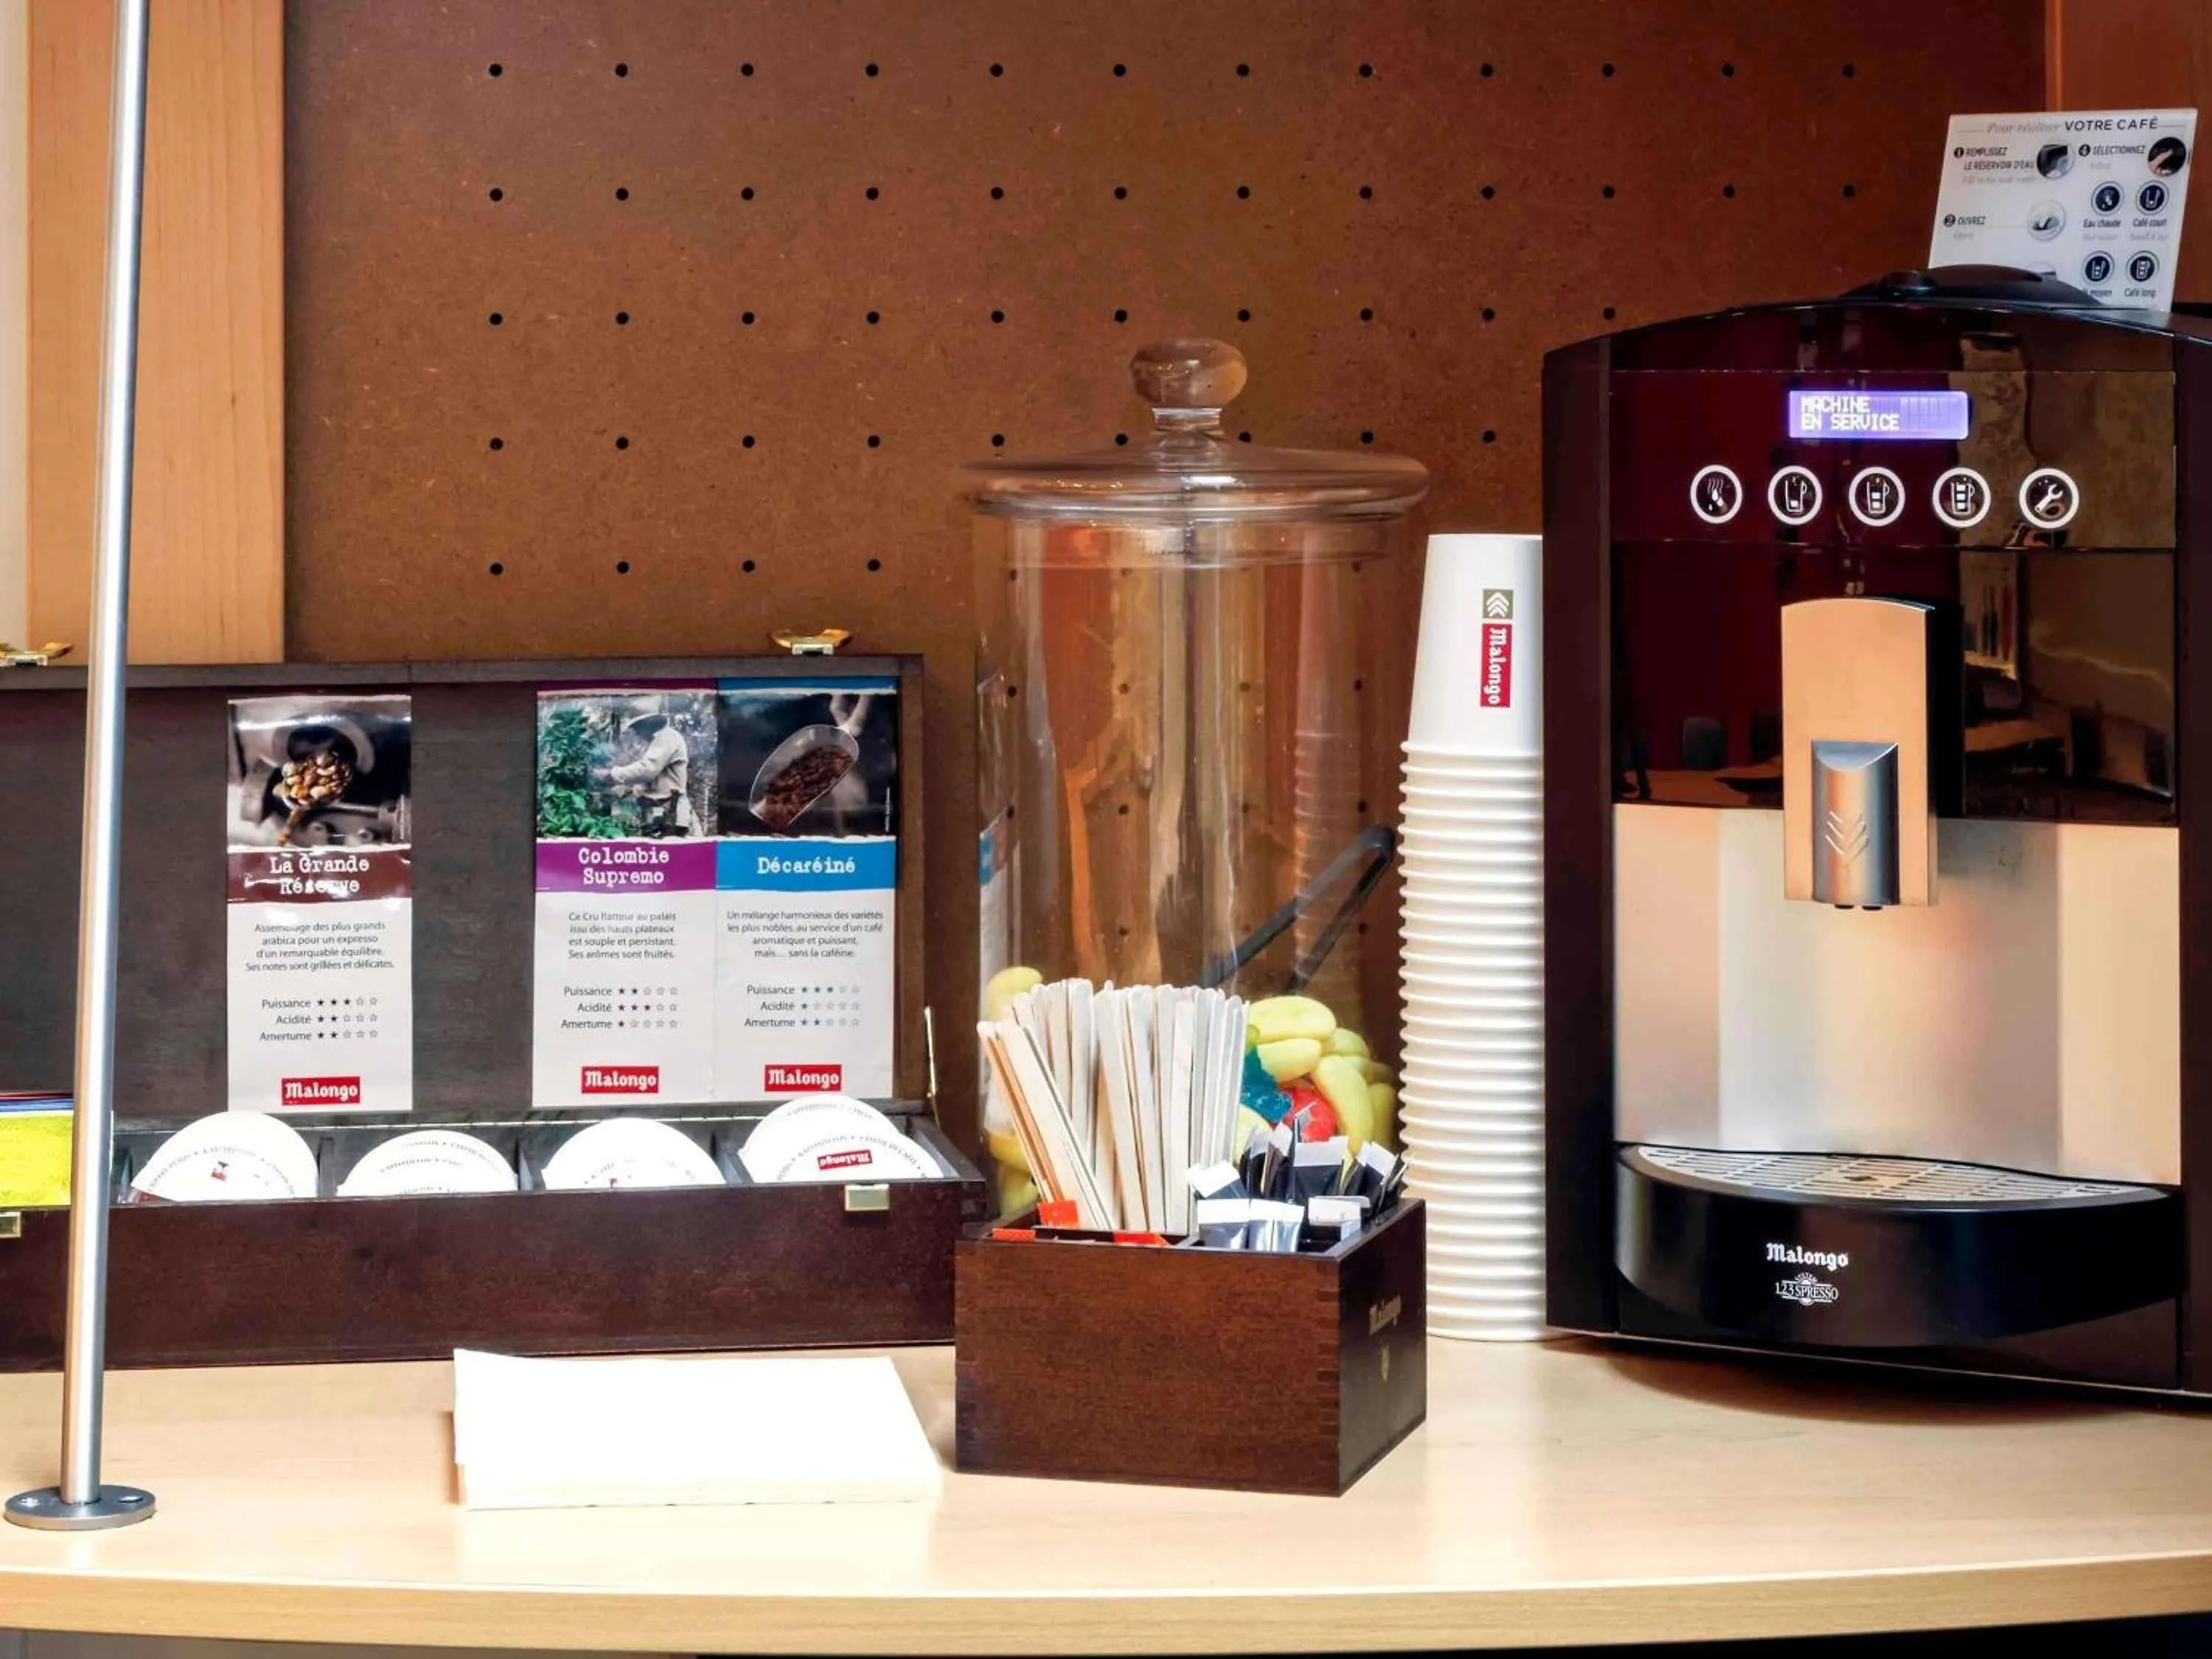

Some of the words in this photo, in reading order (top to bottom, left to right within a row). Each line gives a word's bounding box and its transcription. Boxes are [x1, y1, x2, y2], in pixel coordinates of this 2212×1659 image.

[2065, 119, 2112, 131] VOTRE
[2117, 116, 2158, 131] CAFÉ
[1801, 396, 1870, 413] MACHINE
[1801, 414, 1821, 430] EN
[1831, 414, 1900, 431] SERVICE
[1484, 627, 1507, 705] Malongo
[578, 847, 669, 865] Colombie
[299, 855, 369, 873] Grande
[583, 867, 664, 888] Supremo
[650, 912, 676, 922] palais
[742, 911, 779, 921] mélange
[781, 911, 832, 919] harmonieux
[834, 910, 848, 919] des
[313, 922, 329, 932] des
[353, 921, 386, 932] grands
[635, 925, 675, 934] plateaux
[742, 923, 760, 933] plus
[810, 924, 841, 932] service
[864, 922, 883, 932] café
[262, 935, 296, 945] arabica
[298, 937, 321, 947] pour
[322, 936, 335, 944] un
[337, 936, 378, 945] expresso
[585, 937, 616, 947] souple
[753, 936, 805, 945] aromatique
[807, 936, 816, 945] et
[279, 947, 339, 959] remarquable
[622, 950, 642, 958] sont
[789, 950, 808, 958] sans
[810, 949, 818, 957] la
[262, 961, 288, 970] notes
[289, 961, 308, 970] sont
[310, 959, 341, 972] grillées
[343, 960, 352, 968] et
[564, 986, 612, 996] Puissance
[747, 984, 796, 995] Puissance
[262, 998, 311, 1009] Puissance
[577, 1003, 612, 1012] Acidité
[760, 1001, 796, 1011] Acidité
[276, 1014, 311, 1024] Acidité
[561, 1019, 612, 1029] Amertume
[745, 1018, 796, 1027] Amertume
[260, 1031, 312, 1041] Amertume
[585, 1071, 657, 1091] Malongo
[769, 1069, 838, 1088] Malongo
[285, 1082, 358, 1102] Malongo
[1766, 1242, 1848, 1271] Malongo
